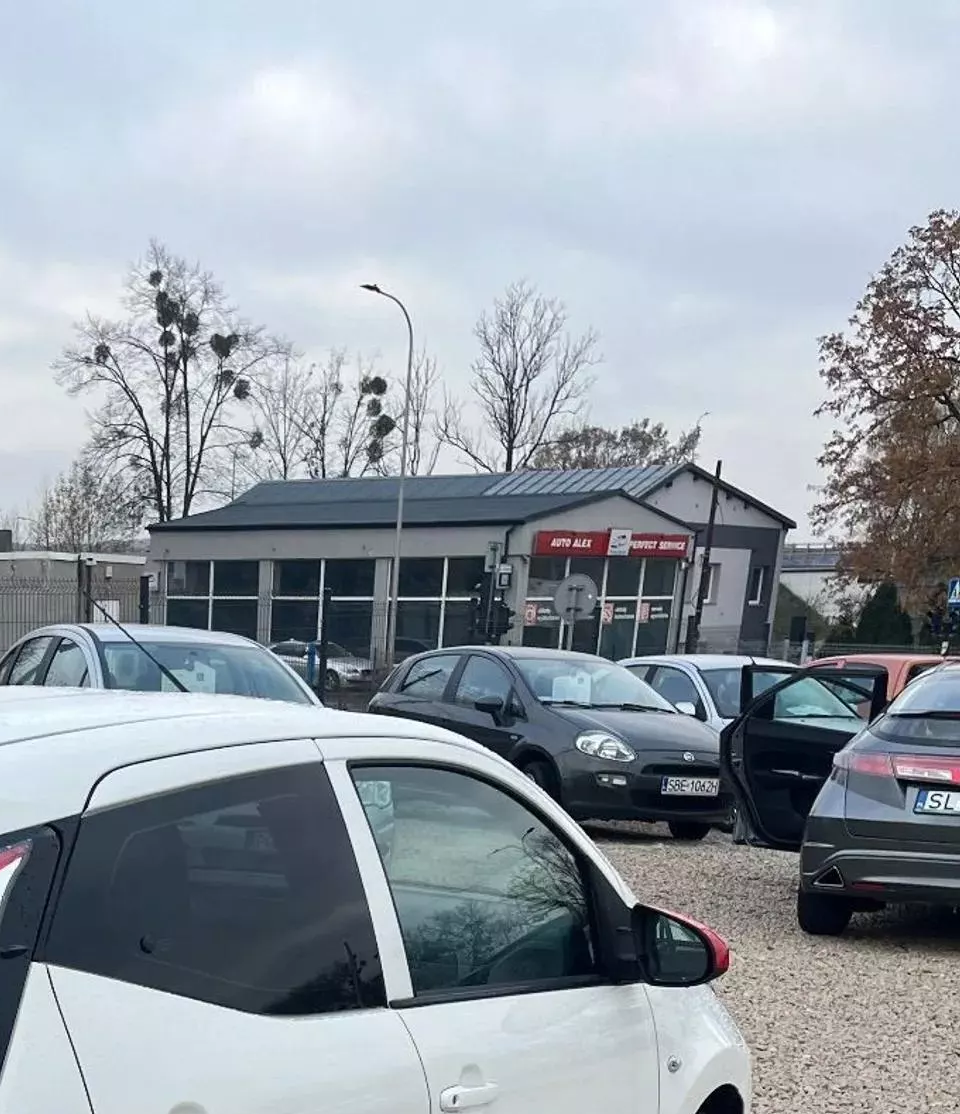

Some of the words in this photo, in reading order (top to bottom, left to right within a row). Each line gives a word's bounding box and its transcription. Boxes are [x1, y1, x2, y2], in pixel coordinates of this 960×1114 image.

[551, 538, 571, 548] AUTO
[572, 538, 592, 548] ALEX
[629, 540, 657, 550] PERFECT
[658, 540, 686, 550] SERVICE
[668, 779, 687, 792] SBE
[928, 793, 955, 811] SL
